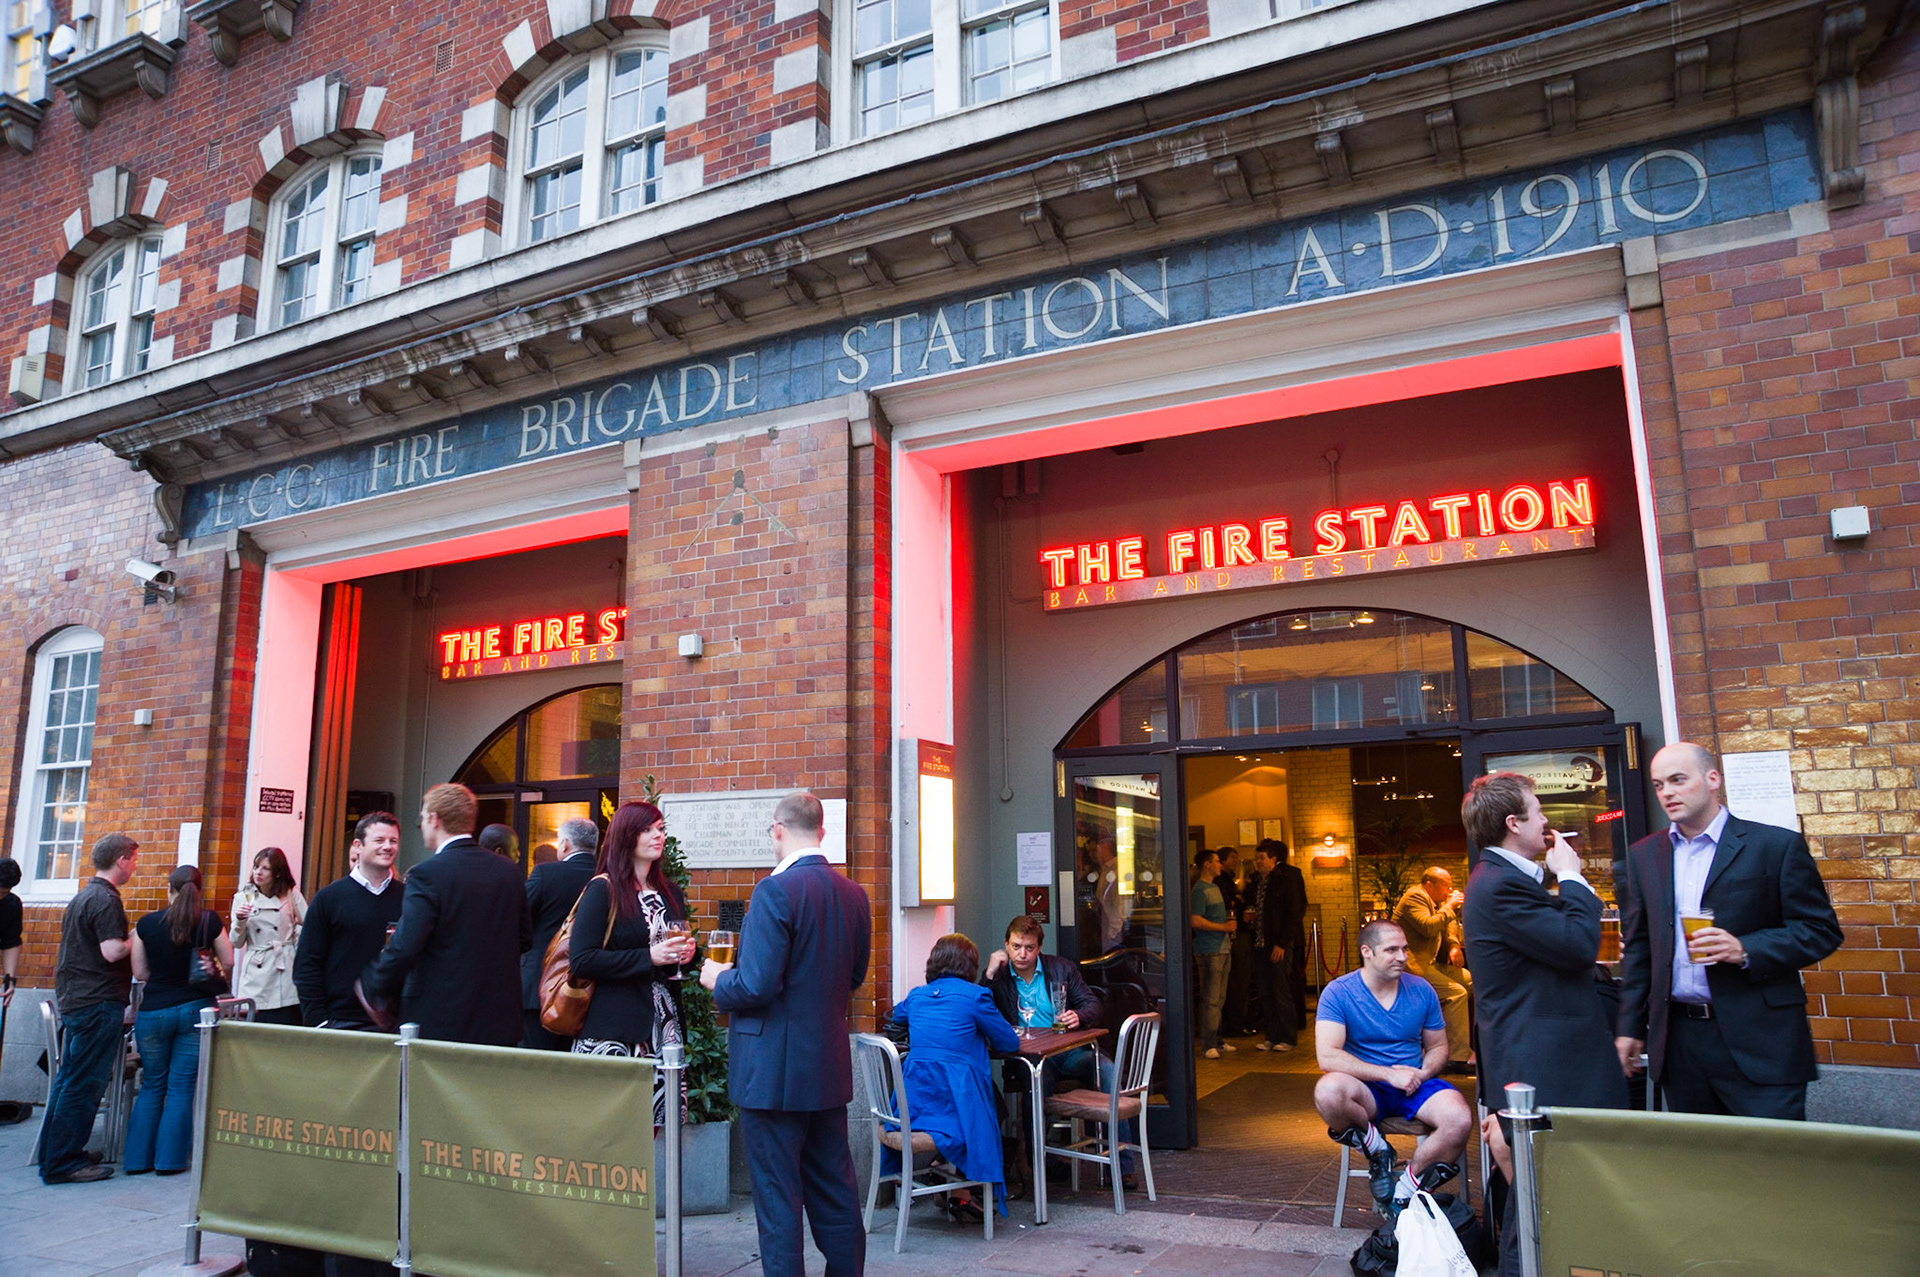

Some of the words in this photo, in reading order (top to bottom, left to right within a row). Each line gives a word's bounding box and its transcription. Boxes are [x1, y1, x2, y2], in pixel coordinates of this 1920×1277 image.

[368, 425, 459, 493] FIRE
[517, 351, 758, 459] BRIGADE
[837, 257, 1170, 385] STATION
[1039, 536, 1145, 589] THE
[1167, 515, 1290, 575] FIRE
[1314, 478, 1594, 555] STATION
[1049, 585, 1116, 608] BAR
[1153, 571, 1231, 595] AND
[1272, 529, 1584, 581] RESTAURANT
[439, 626, 501, 665] THE
[513, 613, 585, 656] FIRE
[597, 607, 627, 645] S
[441, 662, 482, 680] BAR
[502, 653, 549, 672] AND
[570, 645, 616, 664] RES
[692, 804, 720, 812] STATION
[724, 802, 741, 810] WAS
[707, 812, 721, 821] DAY
[725, 812, 735, 820] OF
[741, 811, 759, 821] JUNE
[765, 810, 773, 820] 19
[685, 822, 698, 830] THE
[724, 820, 749, 829] HENRY
[694, 830, 733, 839] CHAIRMAN
[737, 829, 747, 838] OF
[686, 840, 714, 849] BRIGADE
[718, 839, 761, 848] COMMITTEE
[767, 838, 773, 847] O
[715, 848, 746, 857] COUNTY
[752, 847, 775, 856] COUN
[216, 1131, 240, 1143] BAR
[250, 1137, 274, 1149] AND
[286, 1142, 390, 1164] RESTAURANT
[217, 1108, 248, 1133] THE
[254, 1113, 295, 1141] FIRE
[301, 1120, 393, 1153] STATION
[420, 1139, 463, 1168] THE
[471, 1147, 524, 1179] FIRE
[532, 1153, 648, 1194] STATION
[423, 1164, 452, 1178] BAR
[466, 1171, 497, 1186] AND
[512, 1179, 645, 1206] RESTAURANT
